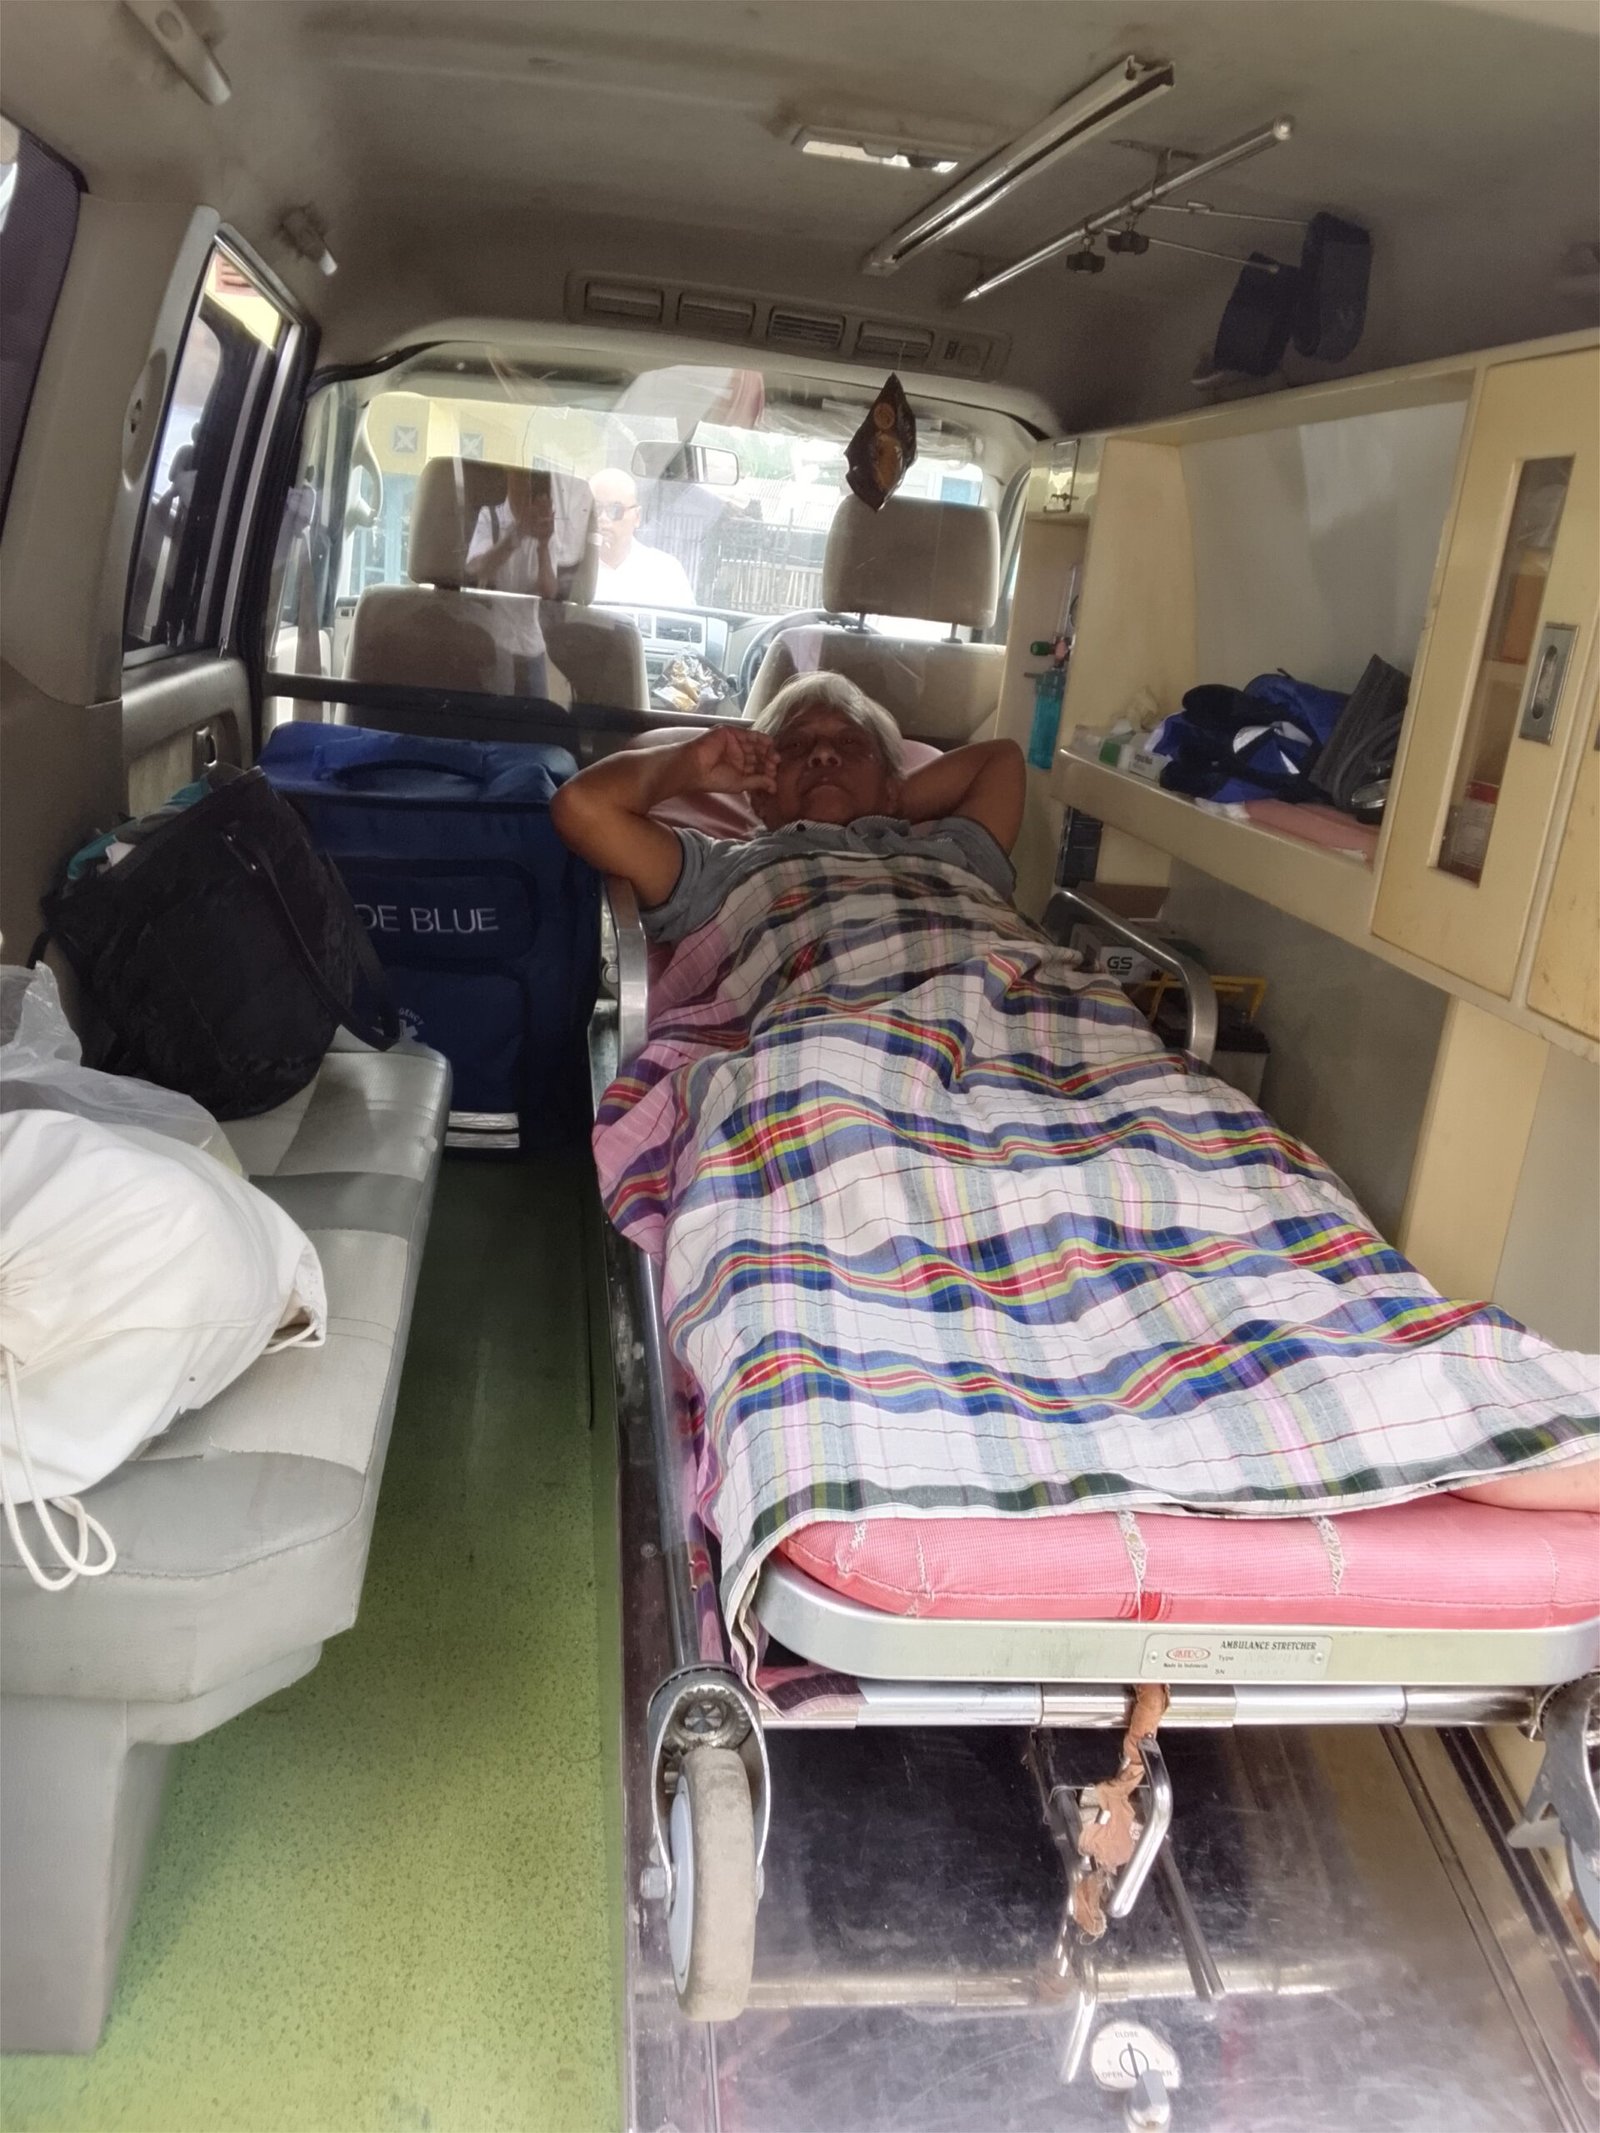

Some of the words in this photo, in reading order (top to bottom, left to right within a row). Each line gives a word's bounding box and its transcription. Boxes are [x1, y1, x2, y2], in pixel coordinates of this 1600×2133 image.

[409, 906, 501, 934] BLUE
[1106, 955, 1133, 970] GS
[1220, 1640, 1269, 1650] AMBULANCE
[1271, 1641, 1317, 1651] STRETCHER
[1218, 1654, 1234, 1662] Type
[1114, 2031, 1139, 2039] CLOSE
[1101, 2071, 1124, 2080] OPEN
